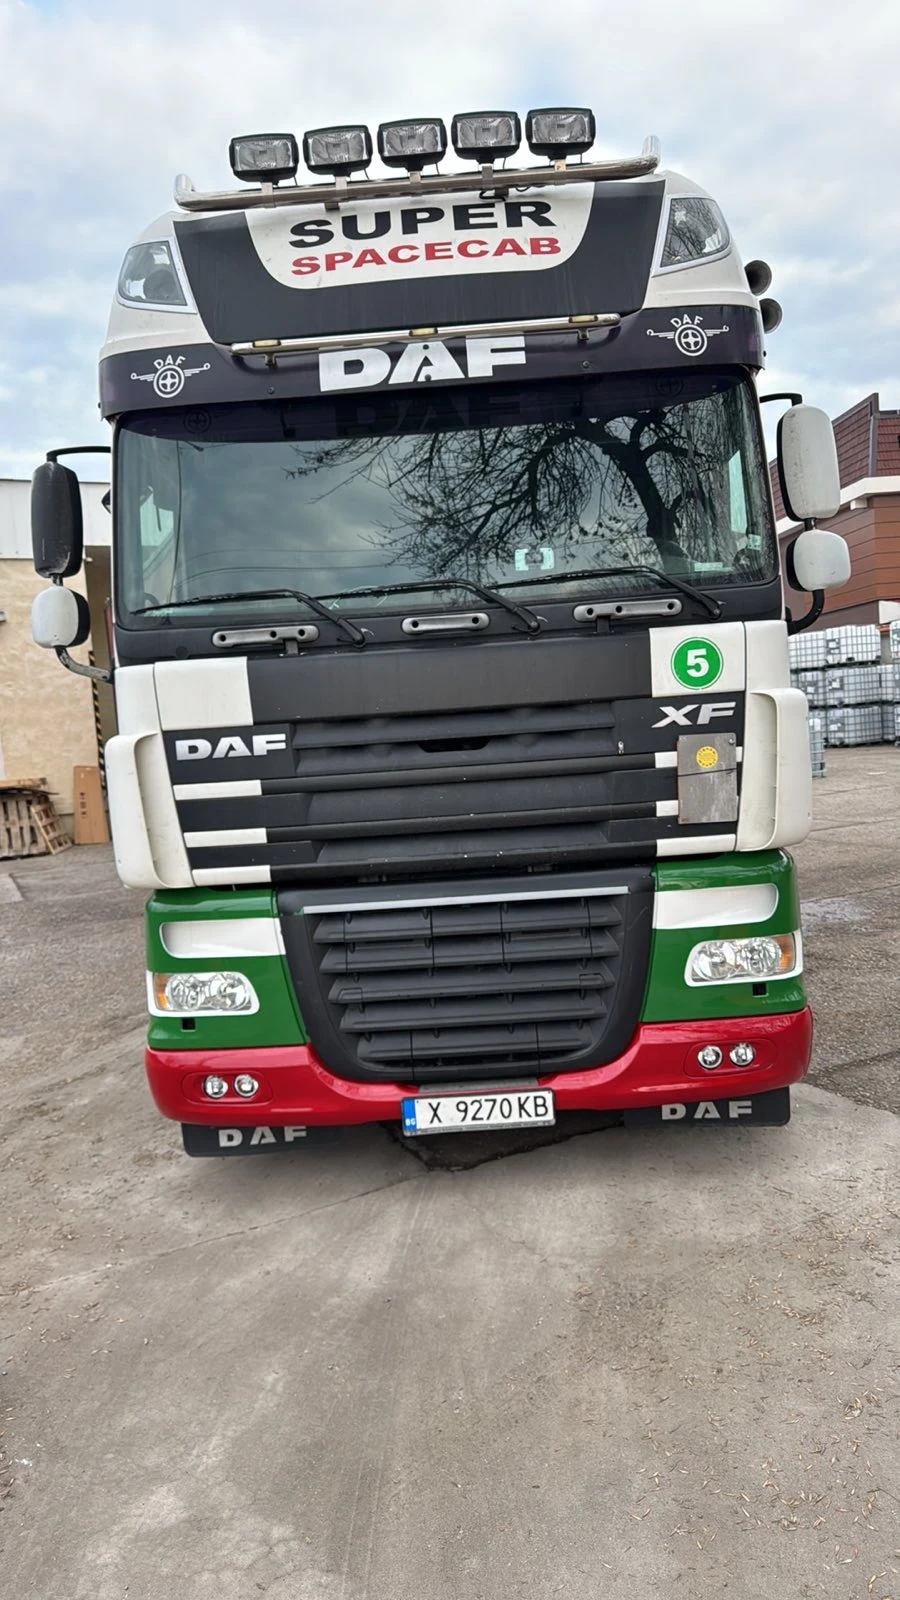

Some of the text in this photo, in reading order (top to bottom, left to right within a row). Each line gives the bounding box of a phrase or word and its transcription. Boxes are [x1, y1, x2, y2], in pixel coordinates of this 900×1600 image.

[289, 200, 557, 249] SUPER
[291, 237, 561, 276] SPACECAB
[670, 313, 703, 328] DAF
[153, 354, 186, 369] DAF
[318, 336, 526, 392] DAF
[686, 648, 710, 678] 5
[651, 701, 736, 728] XF
[175, 733, 287, 761] DAF
[428, 1101, 442, 1124] X
[661, 1100, 752, 1120] DAF
[218, 1126, 307, 1148] DAF
